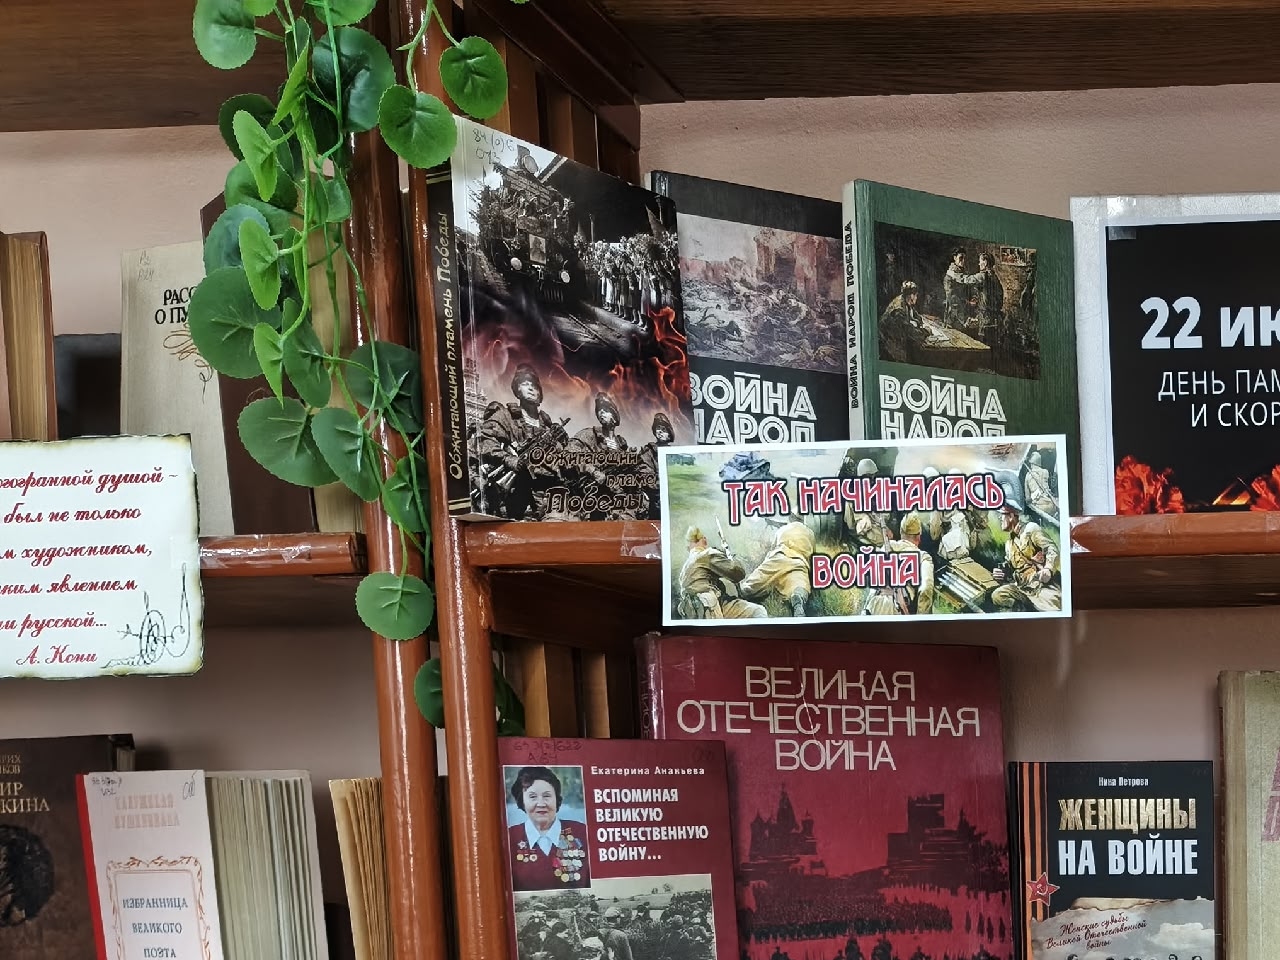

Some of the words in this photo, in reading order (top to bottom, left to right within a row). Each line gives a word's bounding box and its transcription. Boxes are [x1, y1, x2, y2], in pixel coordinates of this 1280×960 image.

[844, 220, 855, 287] ПОБЕДА
[848, 290, 857, 349] НАРОД
[1139, 295, 1204, 350] 22
[690, 371, 817, 420] ВОЙНА
[849, 352, 859, 409] ВОЙНА
[1157, 370, 1226, 402] ДЕНЬ
[878, 373, 1007, 423] ВОЙНА
[442, 357, 463, 480] Обжигающий
[1191, 404, 1208, 428] И
[95, 466, 164, 494] душой
[3, 502, 44, 524] был
[48, 509, 70, 523] не
[74, 507, 142, 522] только
[723, 479, 790, 525] ТАК
[799, 474, 1005, 515] НАЧИНАЛАСЬ
[20, 543, 153, 567] художником,
[811, 546, 921, 590] ВОЙНА
[46, 573, 139, 593] явлением
[44, 644, 99, 665] Кони
[745, 666, 916, 702] ВЕЛИКАЯ
[676, 699, 981, 738] ОТЕЧЕСТВЕННАЯ
[590, 765, 650, 776] Екатерина
[775, 737, 897, 771] ВОЙНА
[593, 788, 679, 804] ВСПОМИНАЯ
[595, 807, 663, 823] ВЕЛИКУЮ
[1058, 797, 1196, 835] ЖЕНЩИНЫ
[596, 825, 709, 842] ОТЕЧЕСТВЕННУЮ
[1058, 840, 1096, 876] НА
[1108, 834, 1199, 876] ВОЙНЕ
[122, 896, 189, 911] ИЗБРАННИЦА
[131, 922, 183, 935] ВЕЛИКОГО
[143, 947, 177, 960] ПОЭТА
